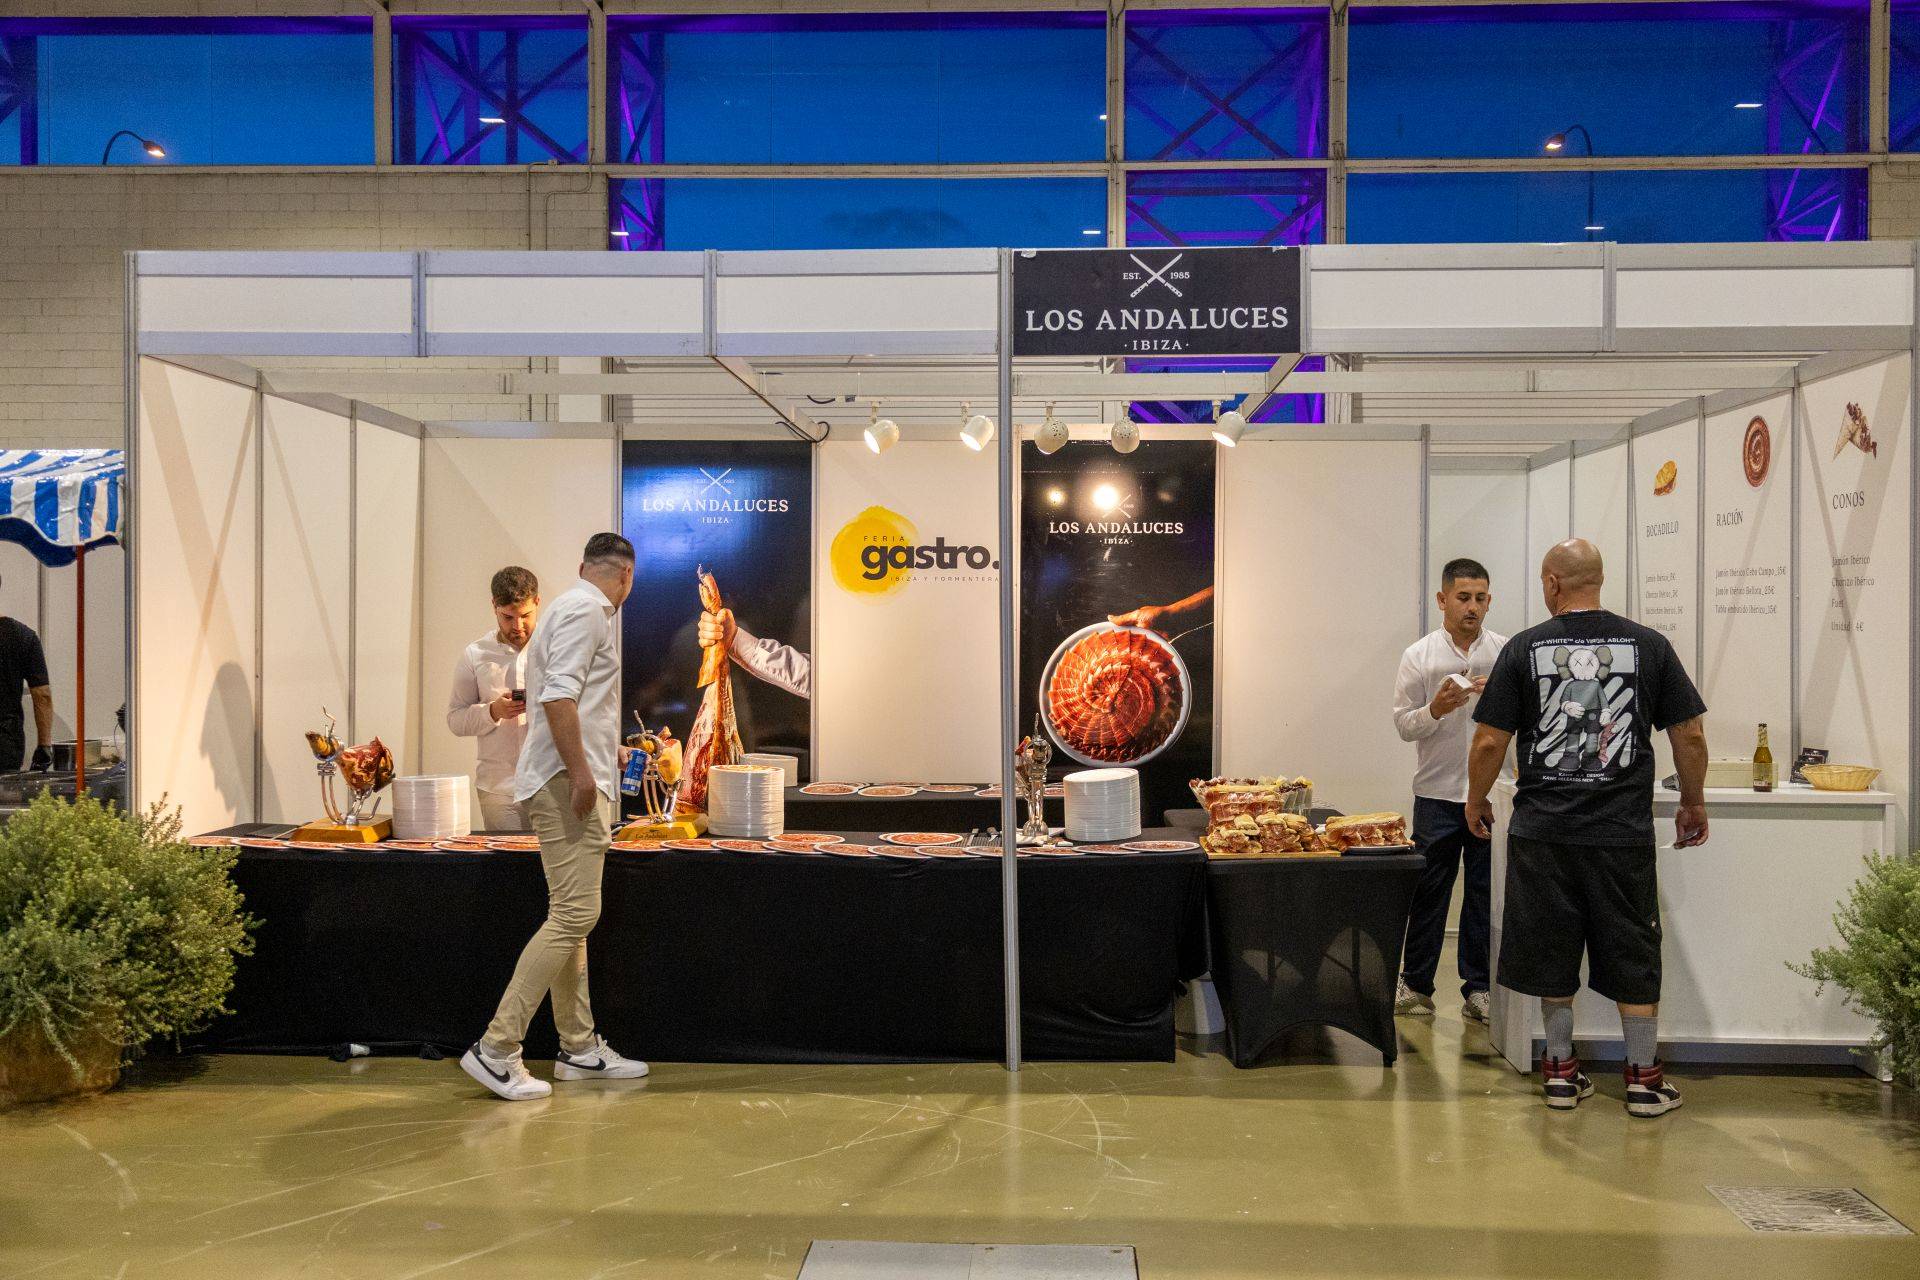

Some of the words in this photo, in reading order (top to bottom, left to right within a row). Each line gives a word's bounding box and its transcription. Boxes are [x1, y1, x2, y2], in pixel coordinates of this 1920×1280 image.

[1122, 272, 1142, 280] EST.
[1169, 271, 1191, 280] 1985
[1025, 309, 1085, 332] LOS
[1095, 306, 1289, 331] ANDALUCES
[1132, 339, 1182, 351] IBIZA
[642, 498, 675, 512] LOS
[680, 499, 789, 512] ANDALUCES
[1832, 490, 1865, 509] CONOS
[702, 516, 729, 524] IBIZA
[1716, 507, 1744, 526] RACIÓN
[1049, 521, 1080, 534] LOS
[1084, 521, 1184, 534] ANDALUCES
[1646, 520, 1679, 538] BOCADILLO
[861, 536, 1000, 581] gastro.
